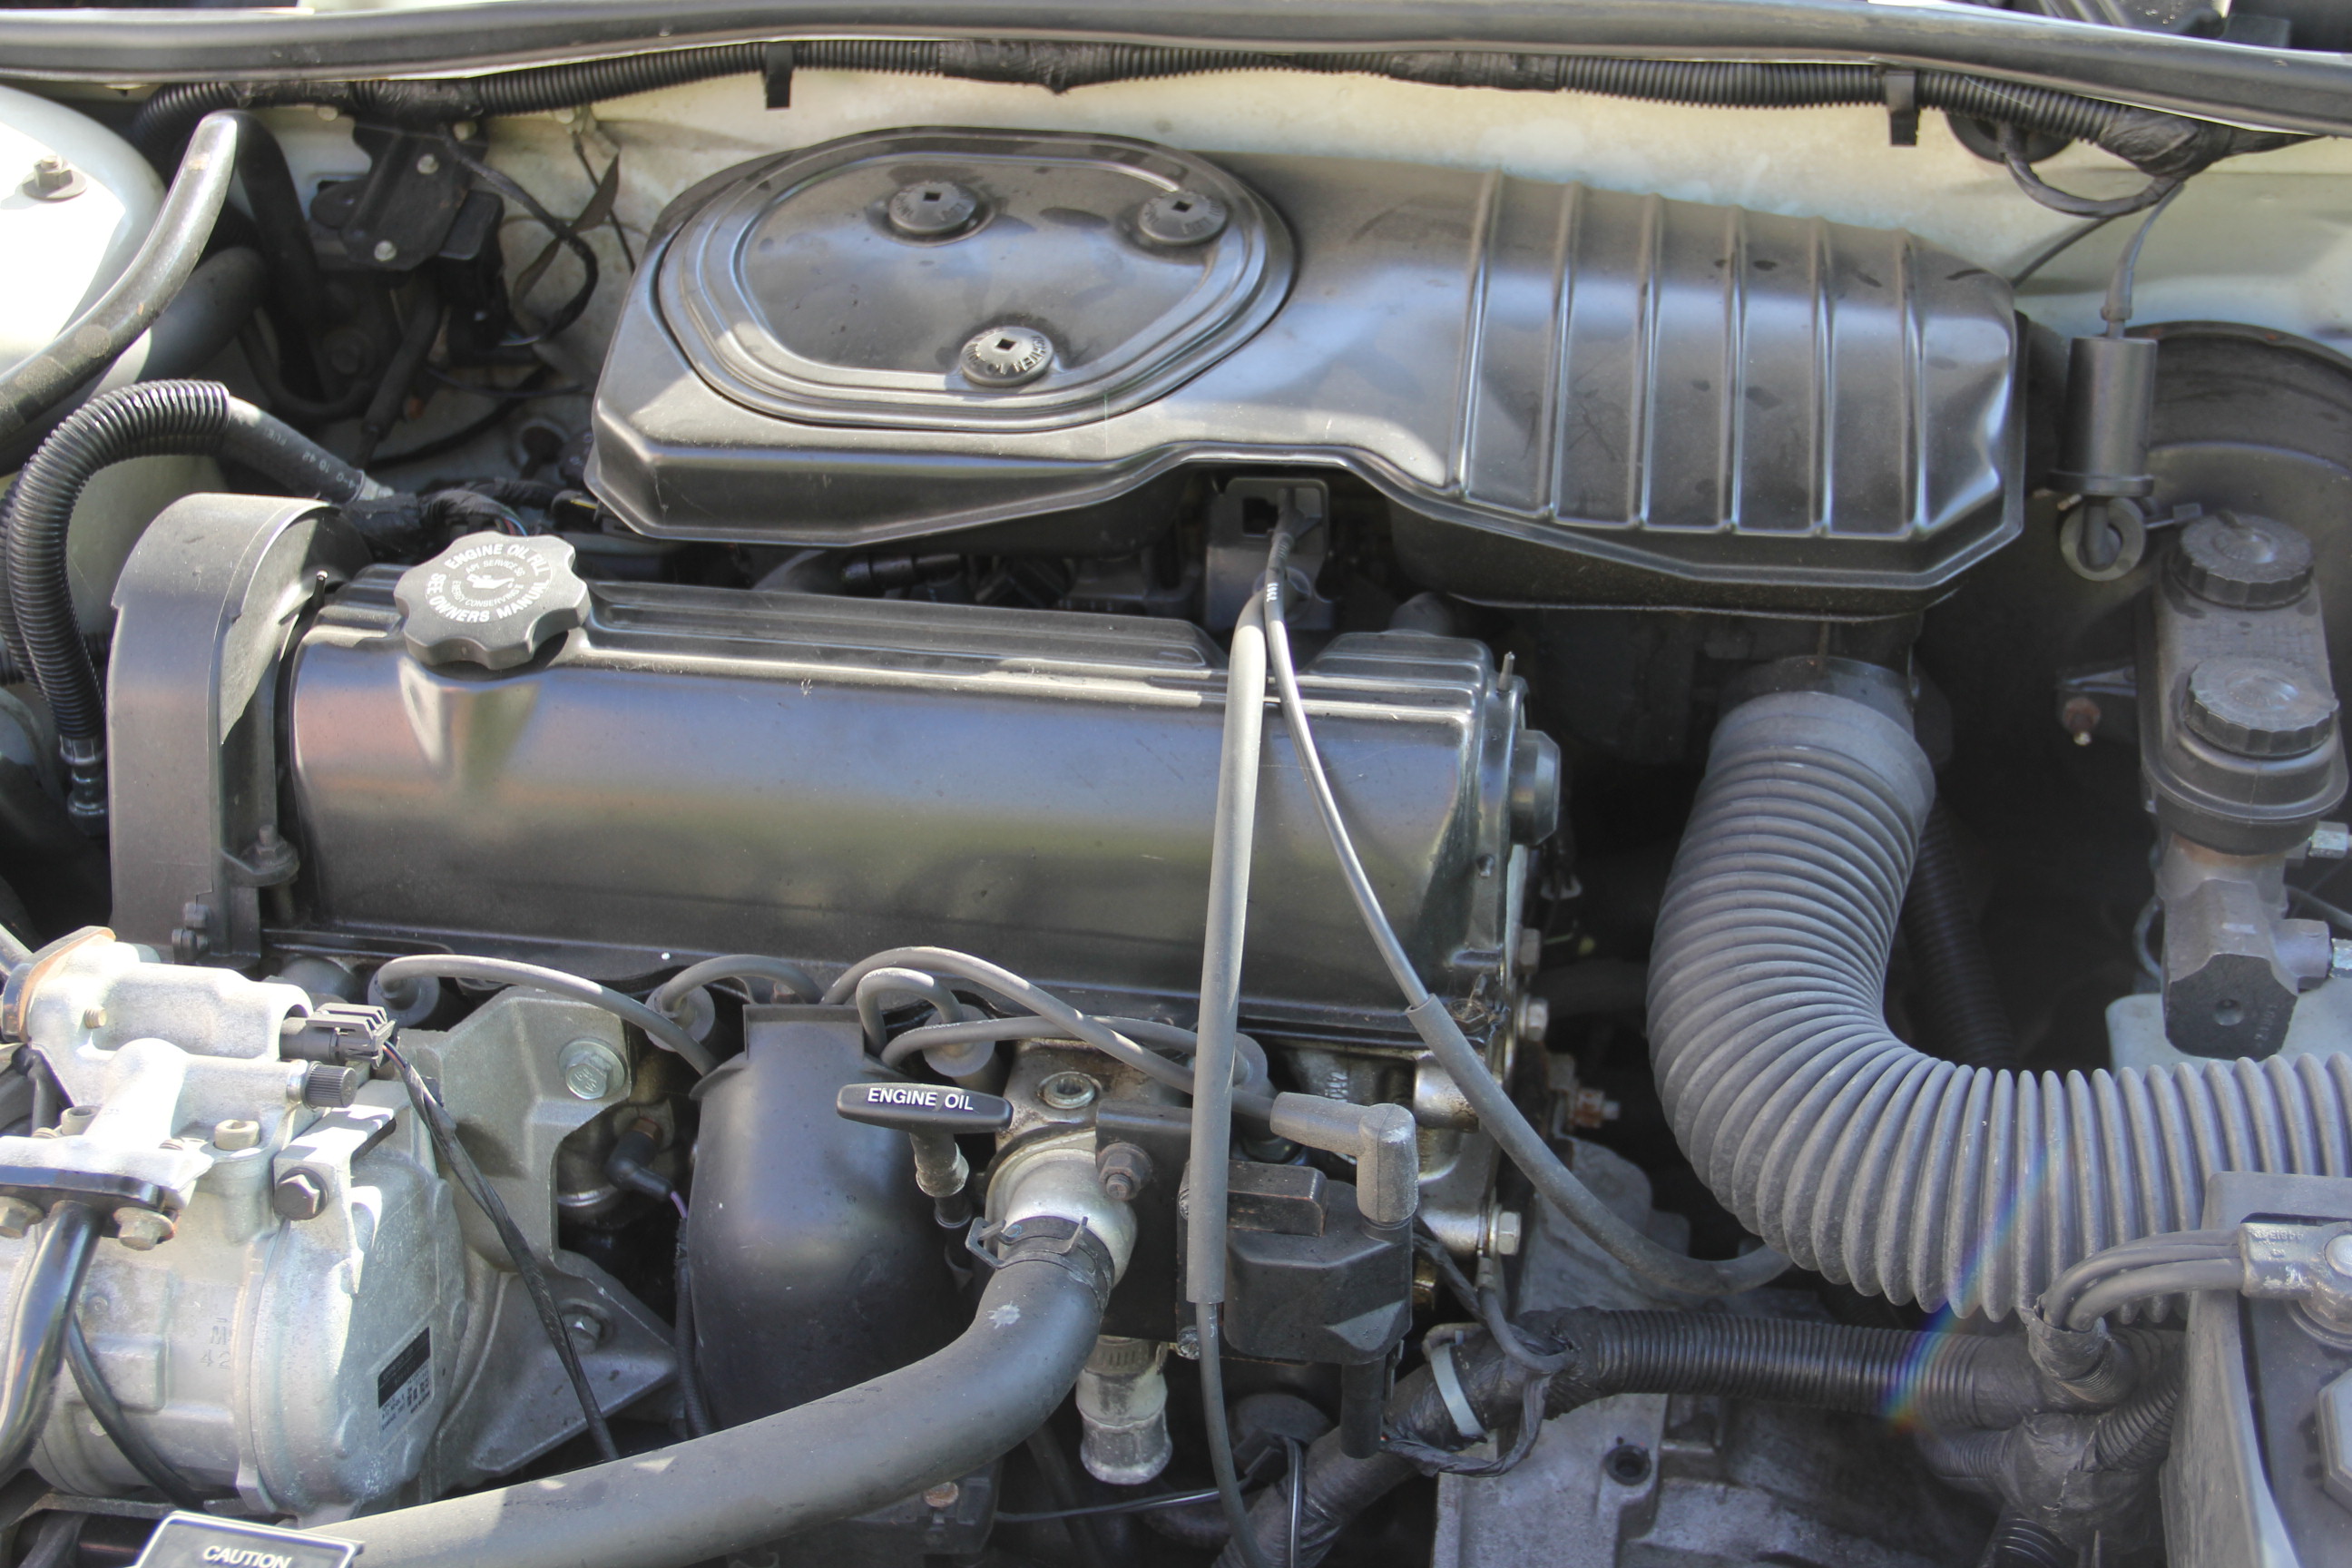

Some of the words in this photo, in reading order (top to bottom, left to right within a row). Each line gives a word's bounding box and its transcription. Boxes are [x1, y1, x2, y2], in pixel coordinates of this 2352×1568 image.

[444, 544, 504, 570] ENGINE
[507, 544, 529, 560] OIL
[527, 554, 550, 576] FILL
[483, 558, 519, 572] SERVICE
[426, 573, 447, 594] SEE
[428, 595, 490, 622] OWNERS
[495, 579, 550, 619] MANUAL
[867, 1086, 938, 1106] ENGINE
[944, 1093, 974, 1112] OIL
[202, 1544, 292, 1568] CAUTION
